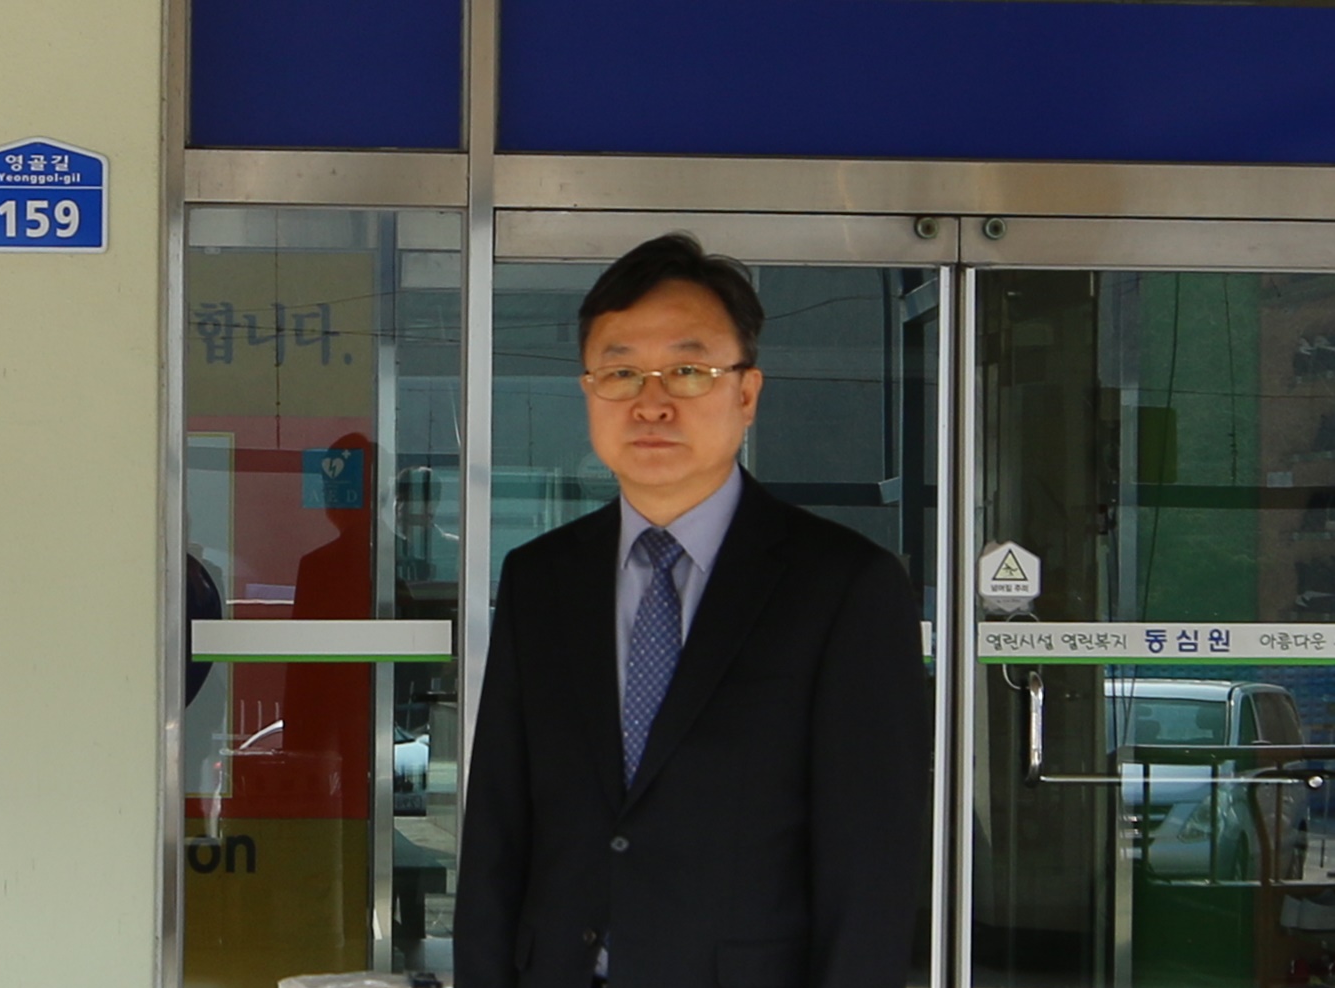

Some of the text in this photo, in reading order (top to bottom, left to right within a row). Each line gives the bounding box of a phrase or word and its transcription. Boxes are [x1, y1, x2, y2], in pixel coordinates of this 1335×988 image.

[5, 154, 69, 171] 영골길
[986, 633, 1054, 651] 열린시설
[1061, 633, 1127, 650] 열린복지
[1259, 632, 1327, 650] 아름다운
